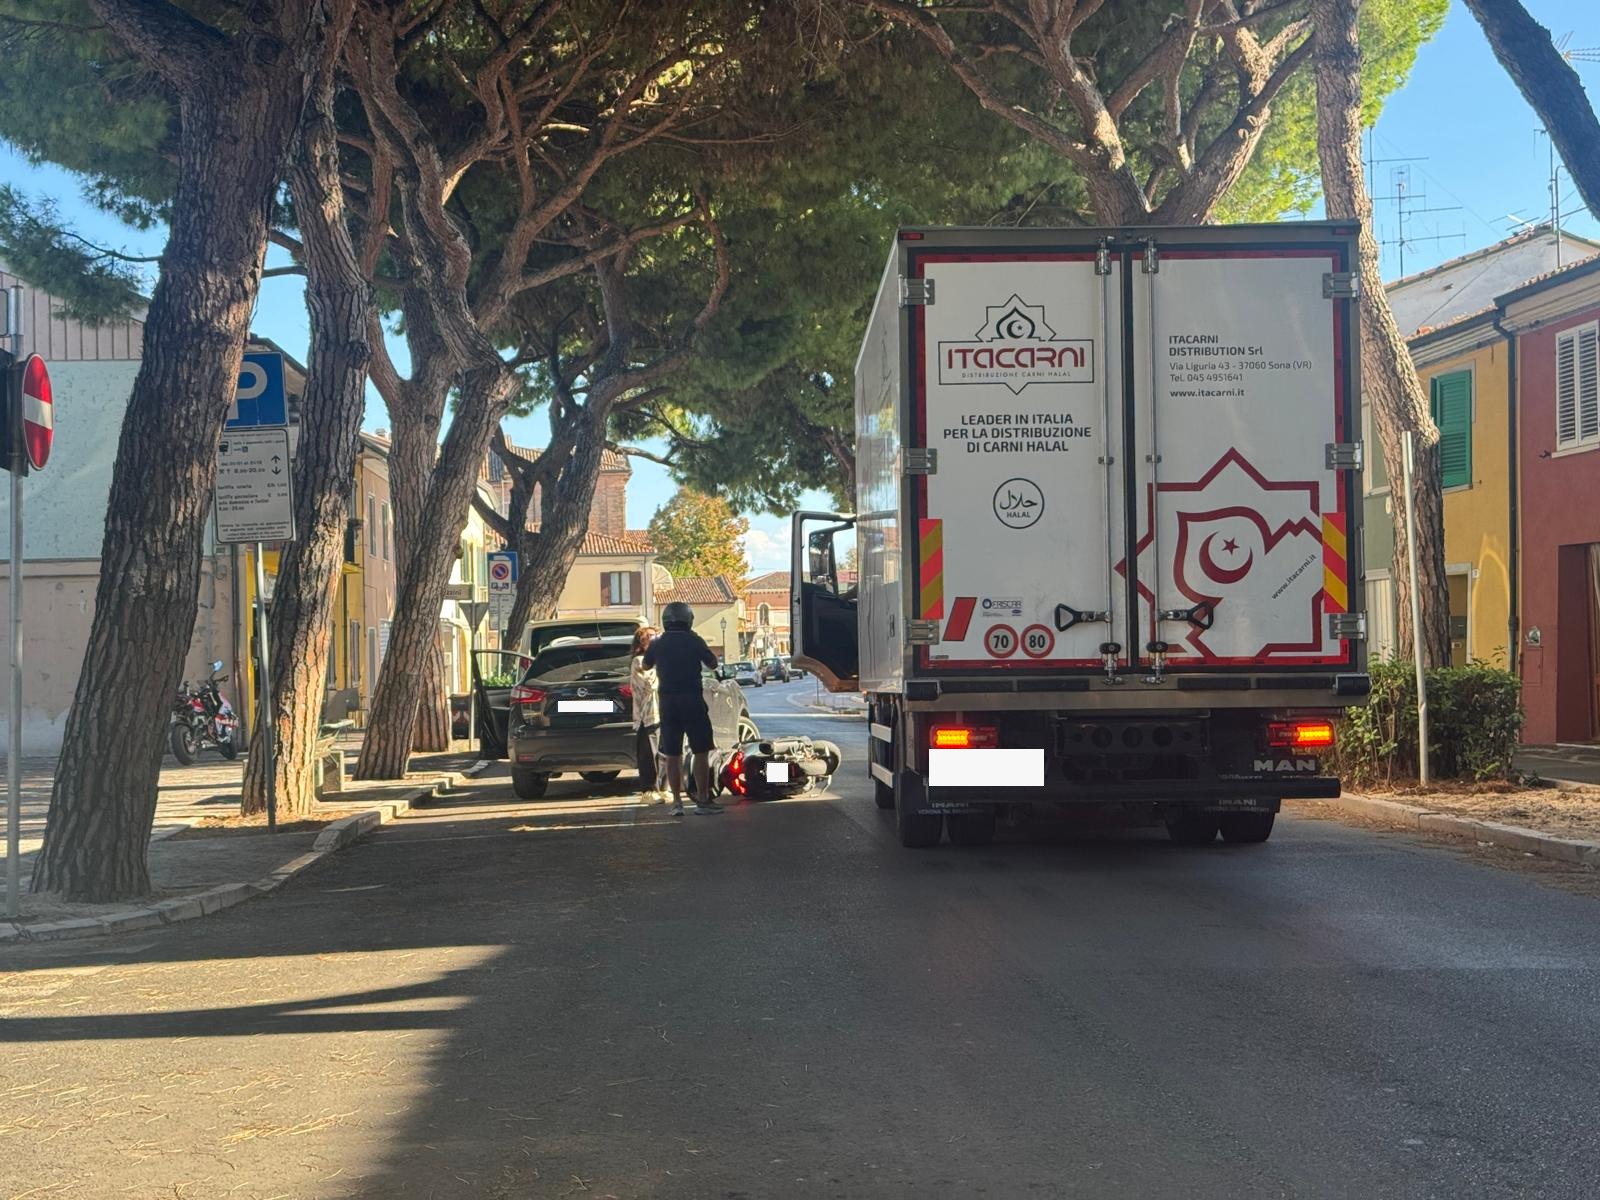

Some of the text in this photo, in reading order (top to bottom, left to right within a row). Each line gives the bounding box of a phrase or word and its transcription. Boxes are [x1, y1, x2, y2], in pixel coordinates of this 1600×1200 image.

[1169, 335, 1219, 345] ITACARNI
[948, 347, 1085, 369] ITACARNI
[1169, 346, 1264, 357] DISTRIBUTION Srl
[1169, 362, 1184, 370] Via
[1185, 362, 1216, 372] Liguria
[1218, 362, 1230, 370] 43
[1238, 361, 1266, 370] 37060
[1268, 361, 1291, 370] Sona
[1292, 360, 1313, 371] (VR)
[1170, 373, 1243, 382] Tel. 045 4951641
[227, 361, 268, 420] P
[1170, 388, 1245, 397] www.itacarni.it
[961, 413, 1073, 425] LEADER IN ITALIA
[943, 426, 1092, 439] PER LA DISTRIBUZIONE
[967, 440, 1069, 453] DI CARNI HALAL
[1000, 489, 1038, 510] حلال
[1271, 553, 1317, 599] www.itacarni.it
[993, 635, 1009, 648] 70
[1029, 634, 1045, 648] 80
[1253, 759, 1316, 772] MAN
